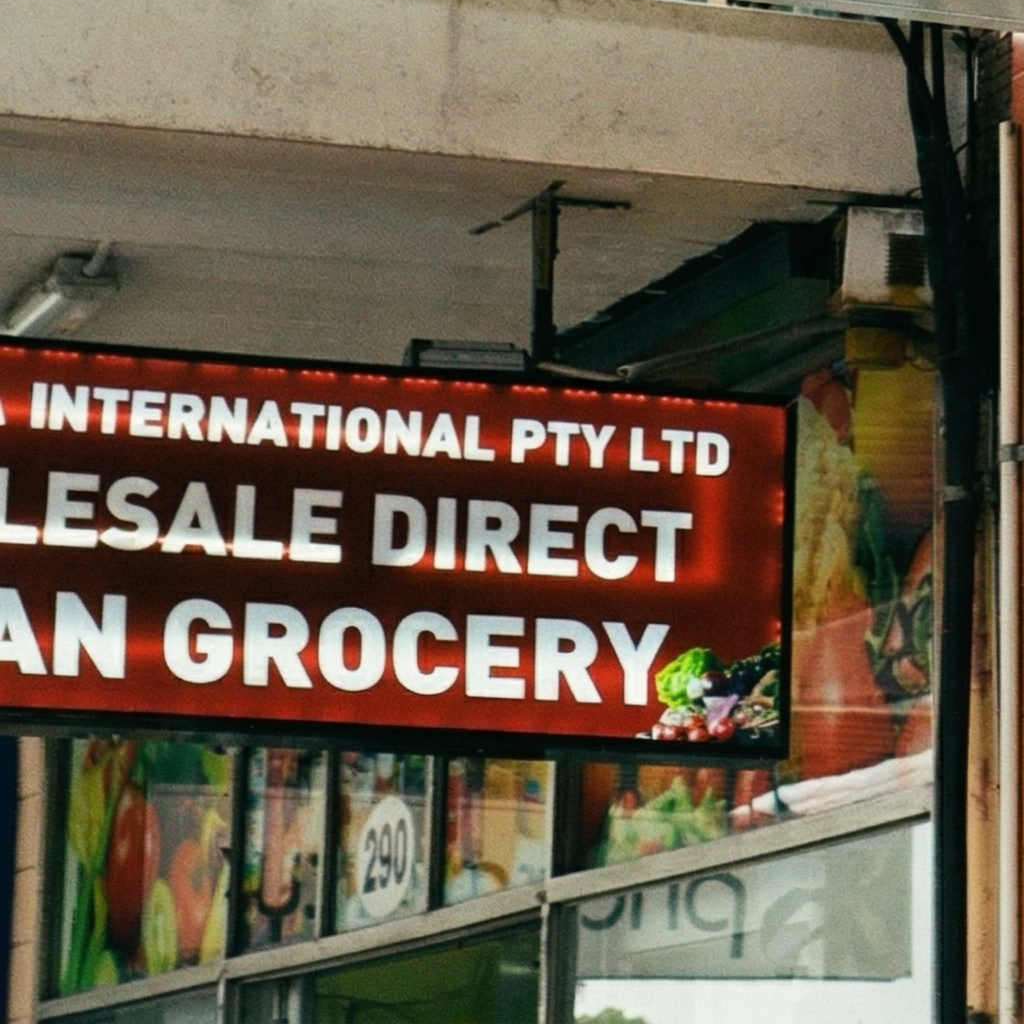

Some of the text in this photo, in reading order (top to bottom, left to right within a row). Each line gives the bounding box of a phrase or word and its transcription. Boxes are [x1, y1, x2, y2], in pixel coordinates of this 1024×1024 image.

[30, 381, 495, 462] INTERNATIONAL
[510, 419, 616, 469] PTY
[628, 426, 731, 477] LTD
[372, 493, 693, 583] DIRECT
[163, 597, 671, 707] GROCERY
[362, 818, 408, 895] 290
